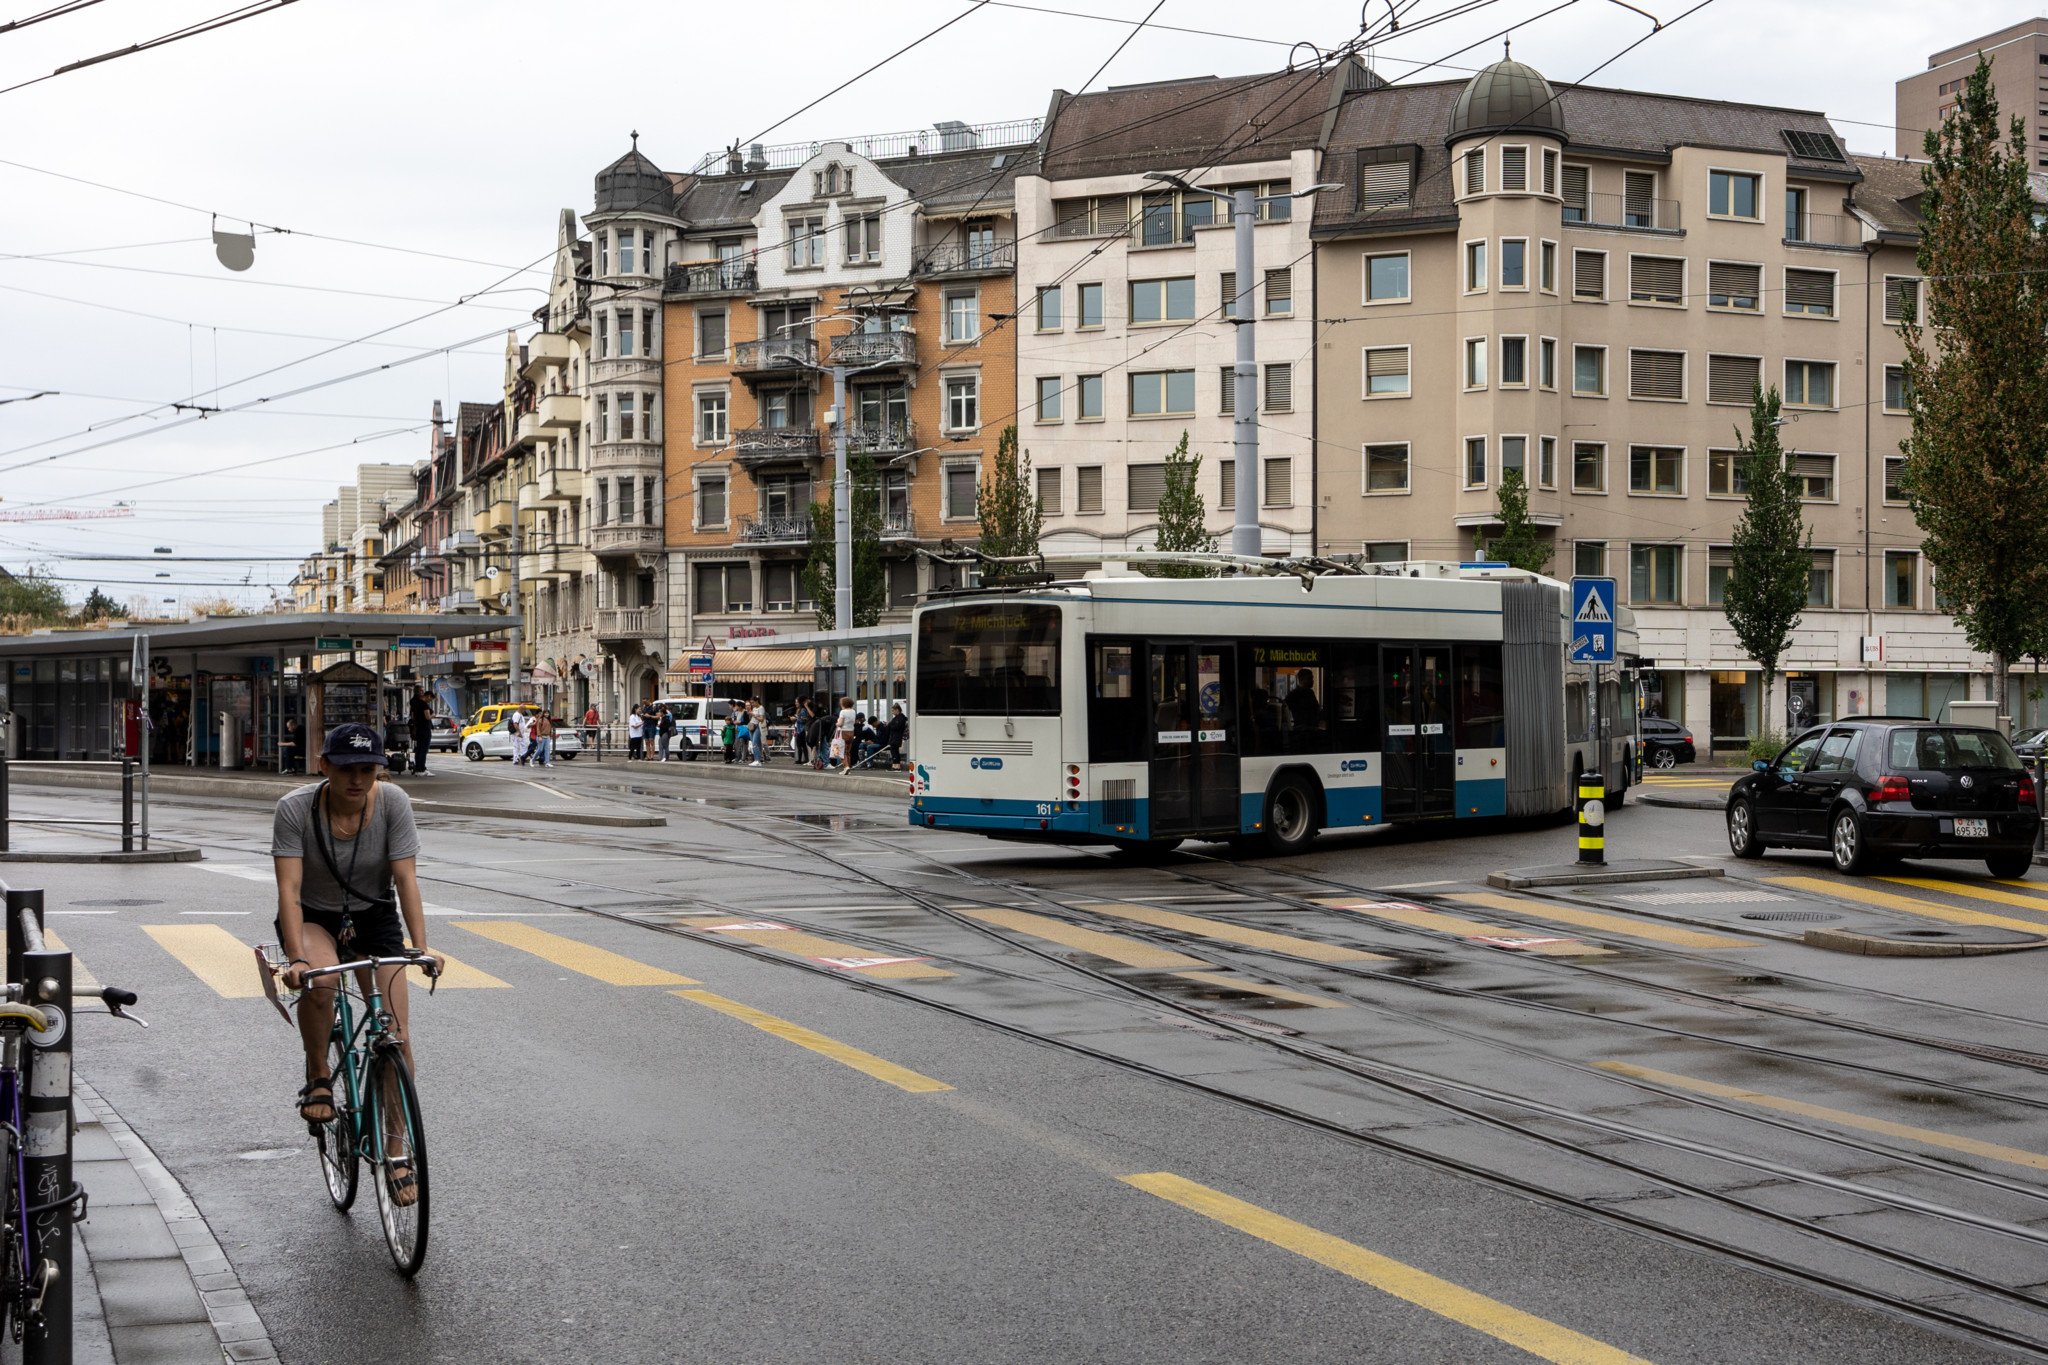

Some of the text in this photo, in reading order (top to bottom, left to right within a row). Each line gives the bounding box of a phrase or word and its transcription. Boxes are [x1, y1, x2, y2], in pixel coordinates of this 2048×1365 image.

[970, 615, 1027, 629] Milchbuck
[1254, 647, 1318, 663] 72 Milchbuck
[1035, 803, 1052, 815] 161
[1966, 818, 1976, 826] ZH
[1956, 826, 1987, 837] 695 329
